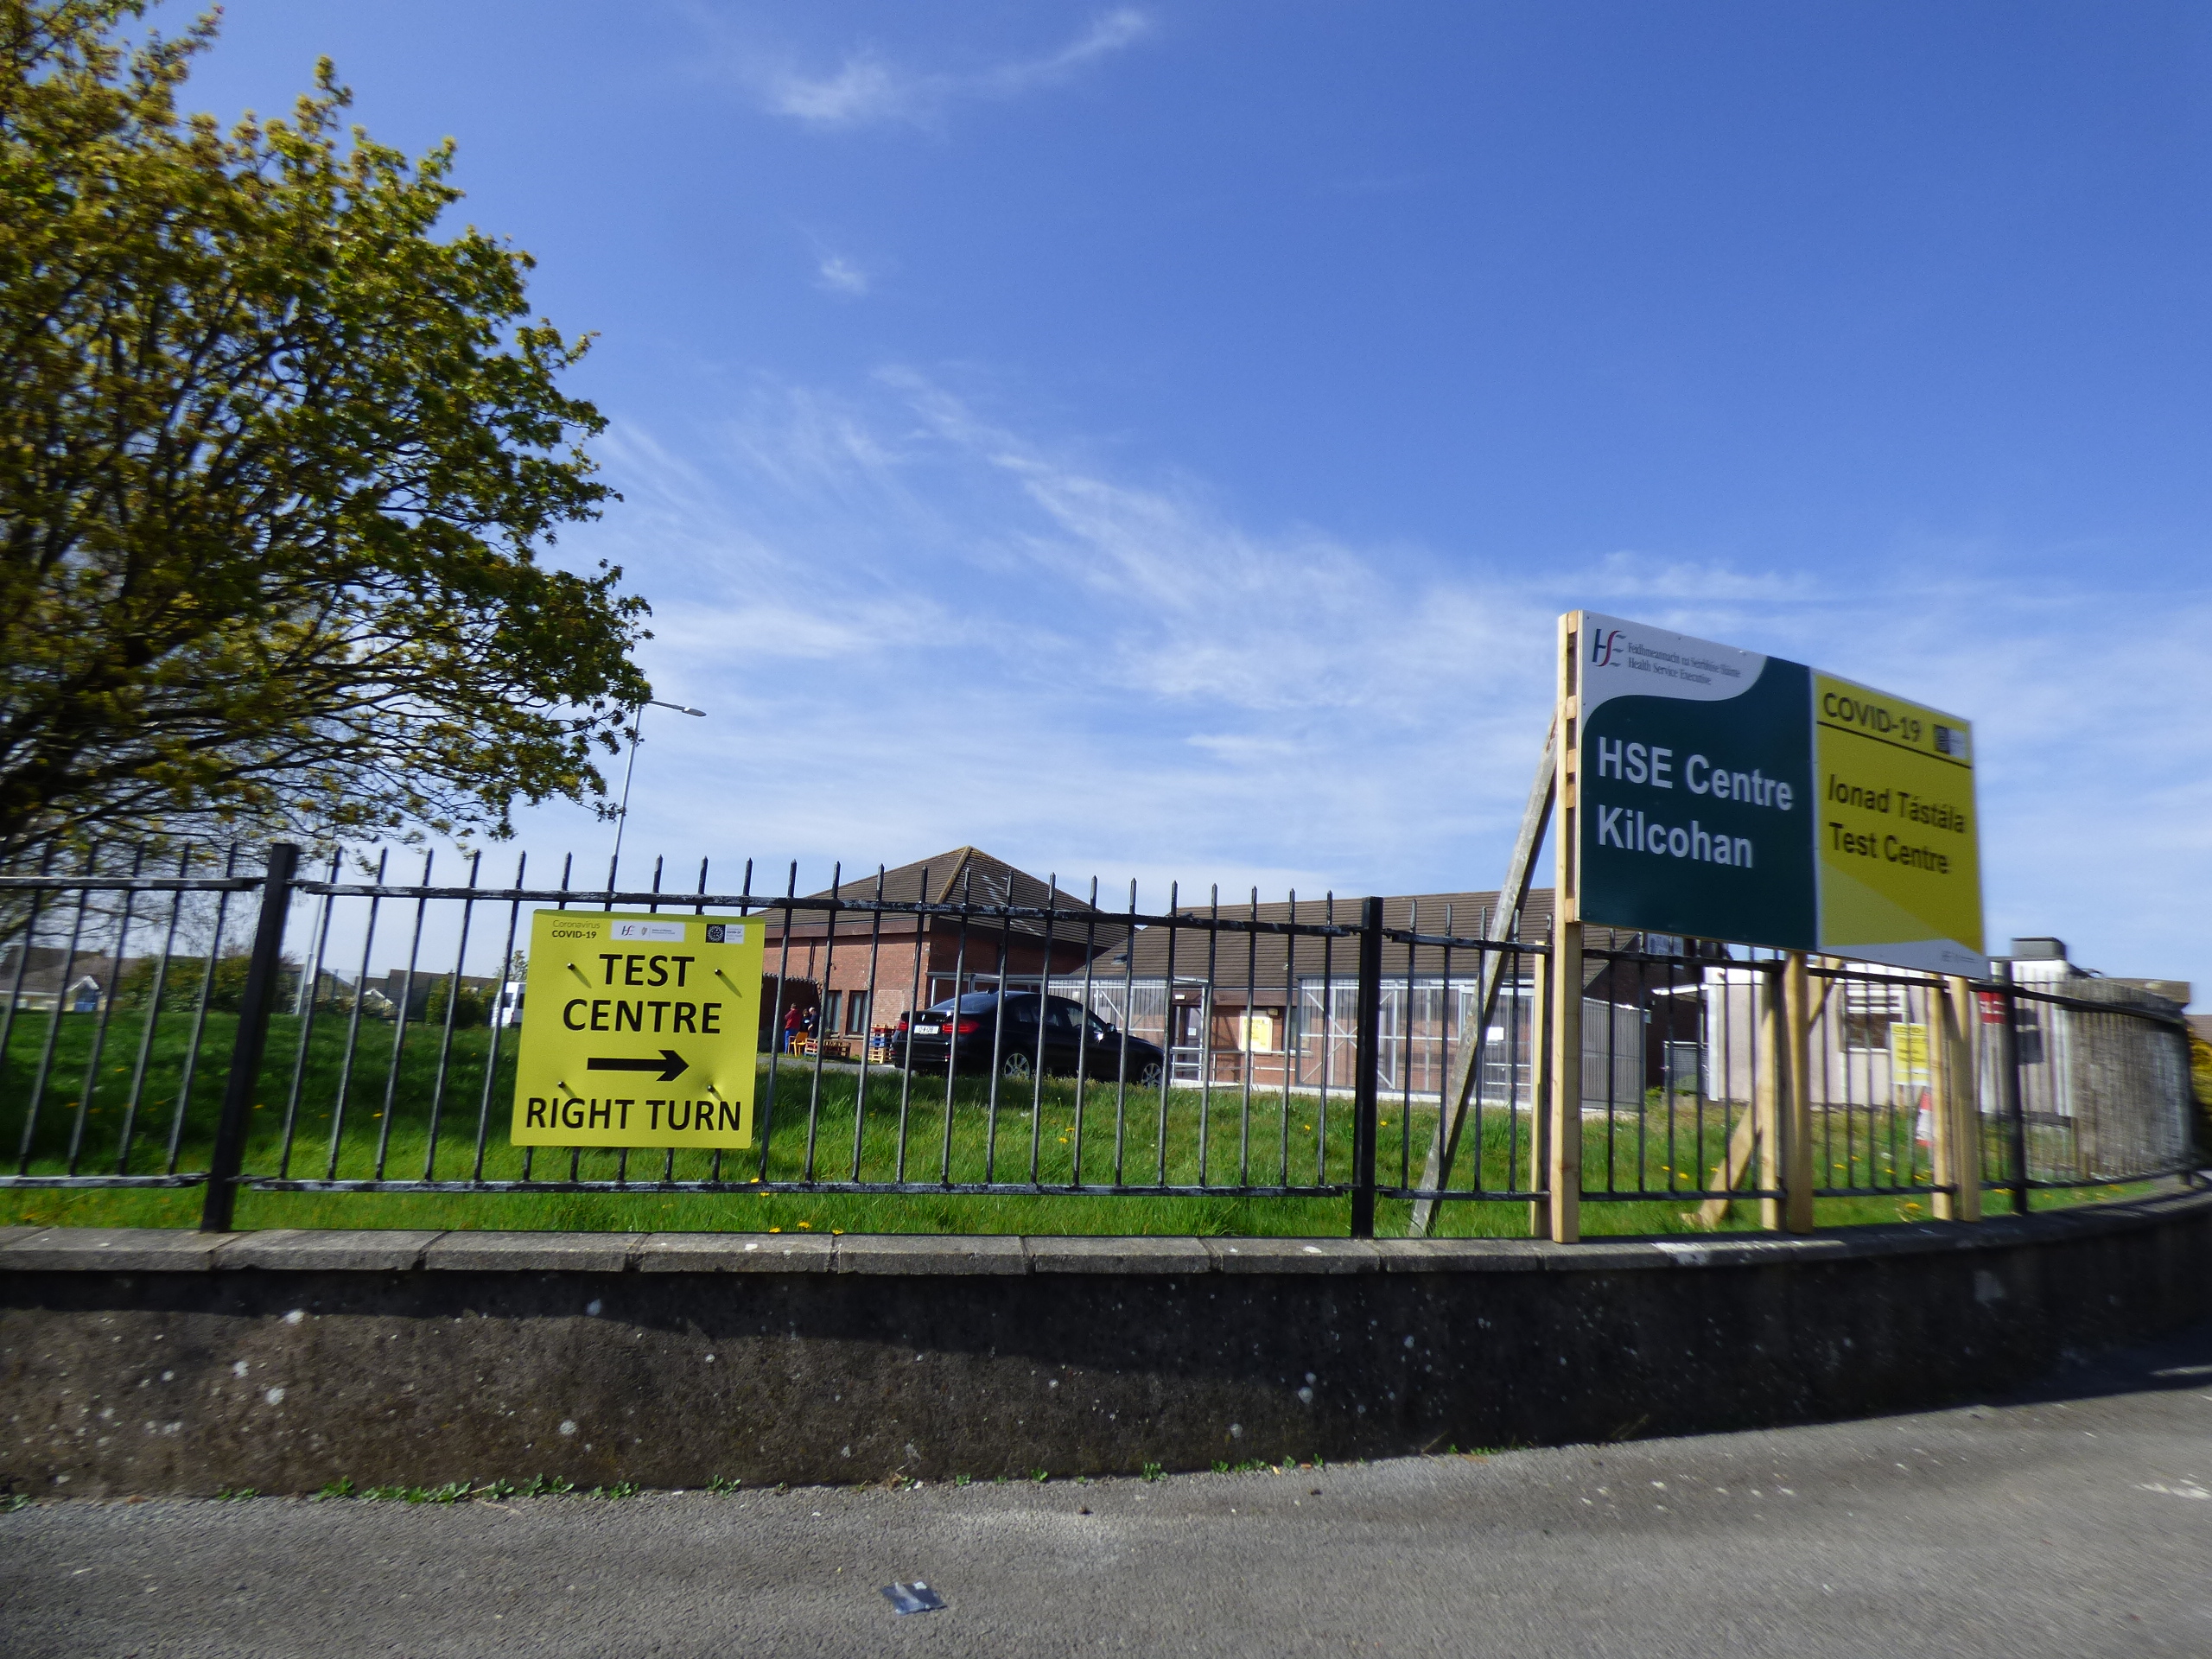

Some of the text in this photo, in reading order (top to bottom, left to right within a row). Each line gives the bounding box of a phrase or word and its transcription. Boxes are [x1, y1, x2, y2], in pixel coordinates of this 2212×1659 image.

[1629, 658, 1651, 671] Health
[1653, 663, 1679, 677] Service
[1824, 692, 1923, 742] COVID-19
[1597, 736, 1795, 811] HSE Centre
[1828, 773, 1890, 814] Ionad
[1598, 804, 1754, 868] Kilcohan
[1829, 823, 1950, 874] Test Centre
[551, 930, 597, 939] COVID-19
[553, 919, 601, 930] Coronavirus
[599, 954, 695, 987] TEST
[563, 999, 722, 1033] CENTRE
[526, 1097, 741, 1131] RIGHT TURN
